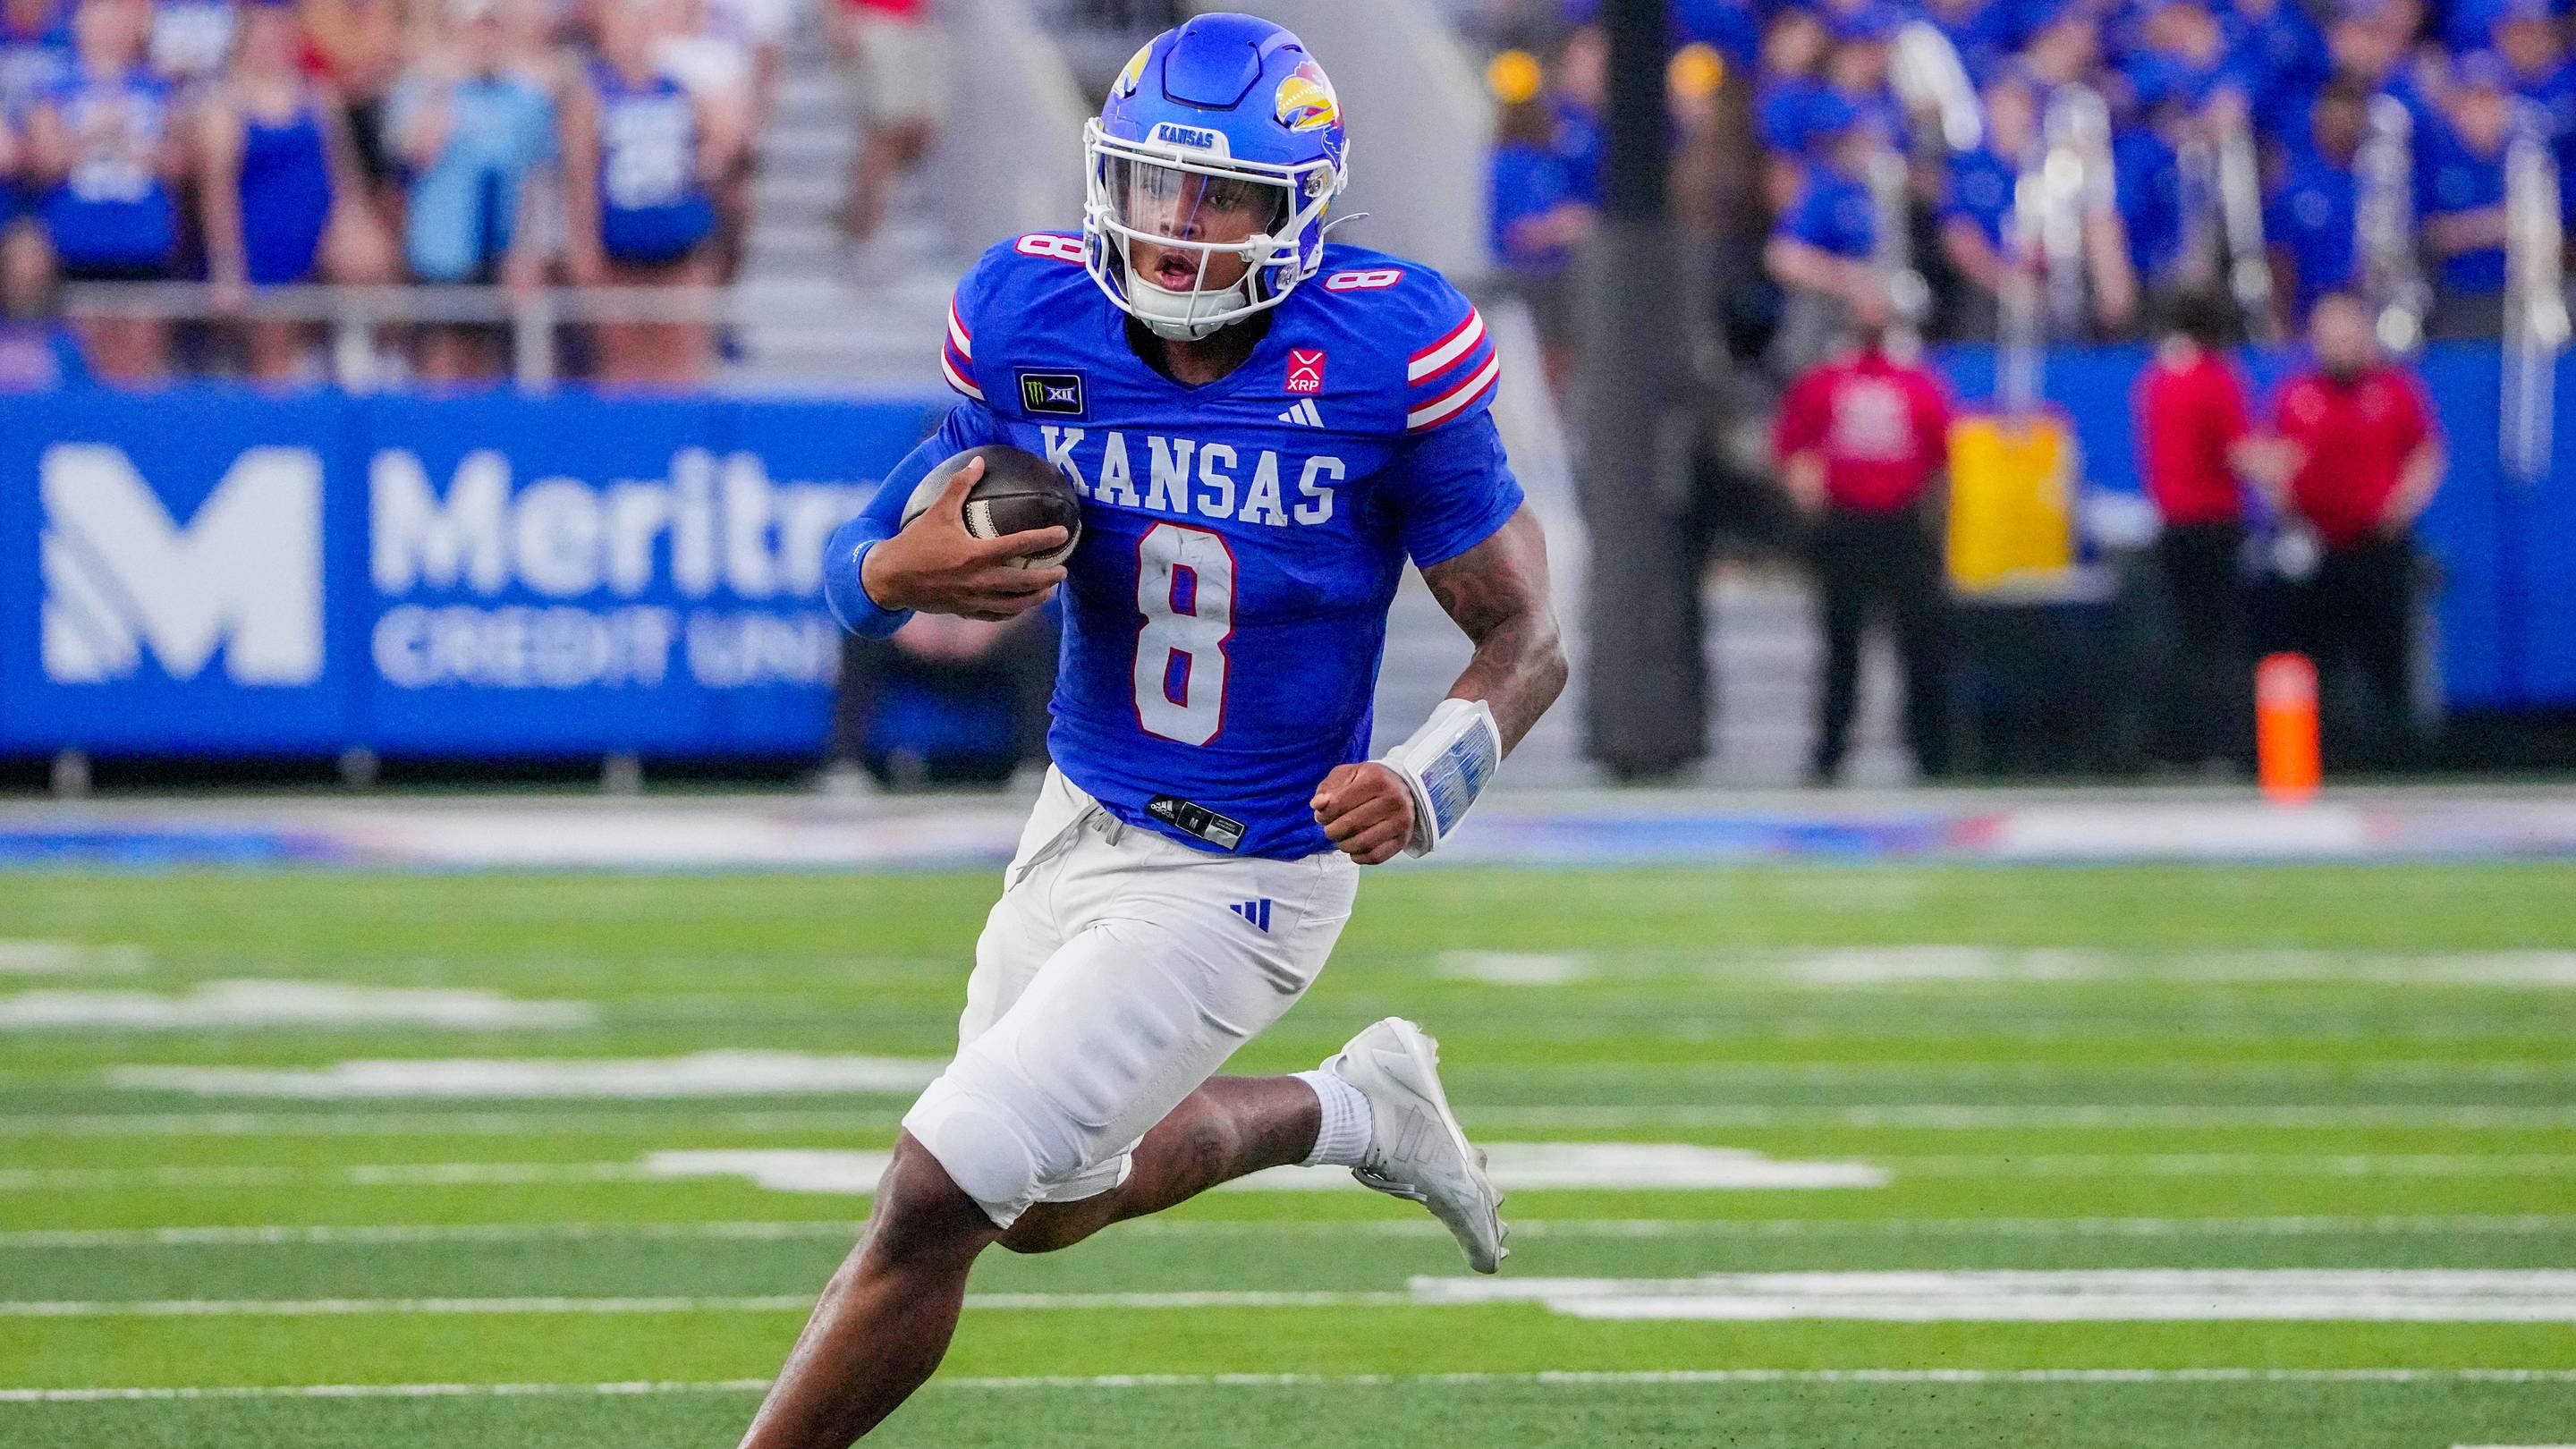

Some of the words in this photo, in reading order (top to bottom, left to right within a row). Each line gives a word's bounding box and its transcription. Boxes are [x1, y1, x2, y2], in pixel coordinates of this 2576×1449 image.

[1158, 124, 1214, 148] KANSAS
[1014, 233, 1087, 267] 8
[1322, 268, 1403, 293] 8
[1288, 378, 1319, 391] XRP
[1041, 425, 1345, 527] KANSAS
[371, 606, 676, 688] CREDIT
[1132, 520, 1237, 747] 8
[1189, 817, 1199, 830] M
